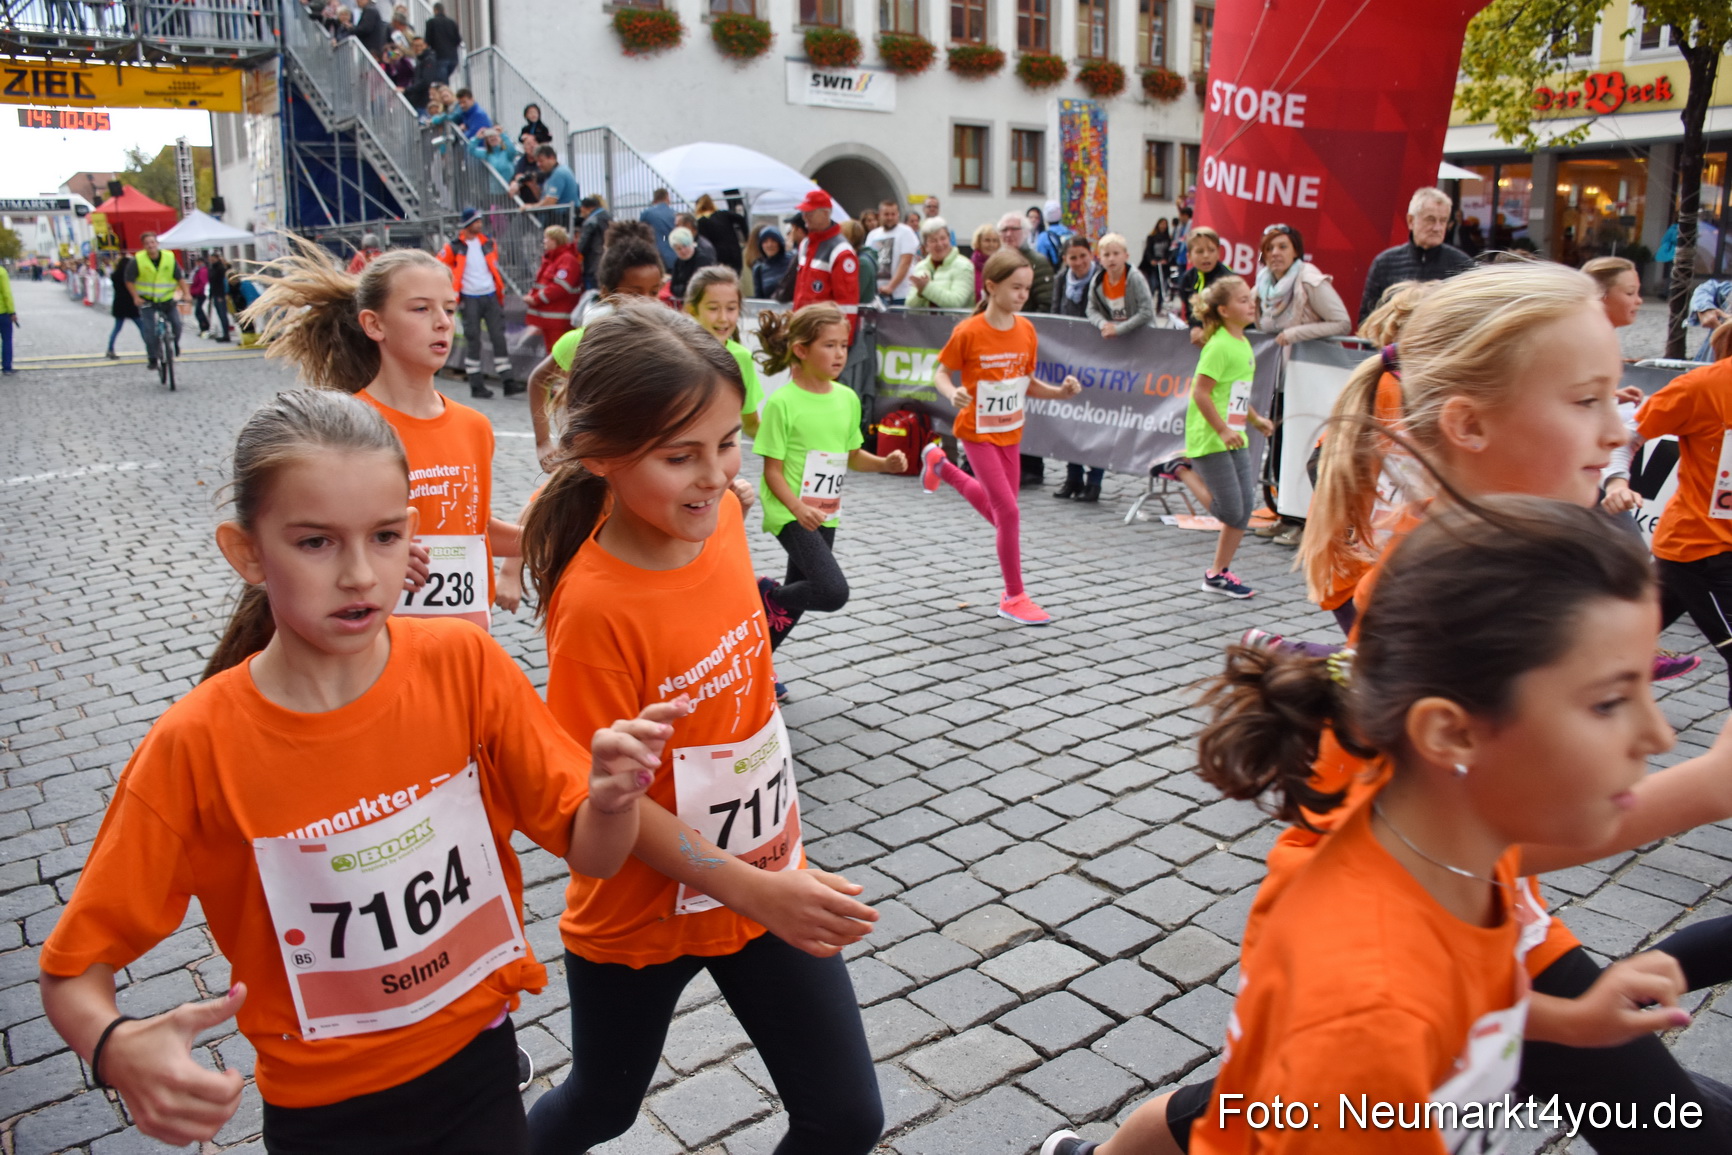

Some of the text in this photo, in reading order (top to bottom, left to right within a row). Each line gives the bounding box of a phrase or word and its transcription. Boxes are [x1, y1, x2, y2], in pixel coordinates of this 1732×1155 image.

[811, 73, 853, 90] swn
[1584, 71, 1673, 114] Beck
[1210, 79, 1307, 128] STORE
[1203, 155, 1320, 209] ONLINE
[1144, 373, 1192, 398] LOU
[408, 465, 460, 481] umarkter
[814, 472, 844, 494] 719
[658, 619, 749, 699] Neumarkter
[357, 816, 434, 867] BOCK
[309, 844, 471, 959] 7164
[295, 954, 312, 965] B5
[381, 951, 450, 994] Selma
